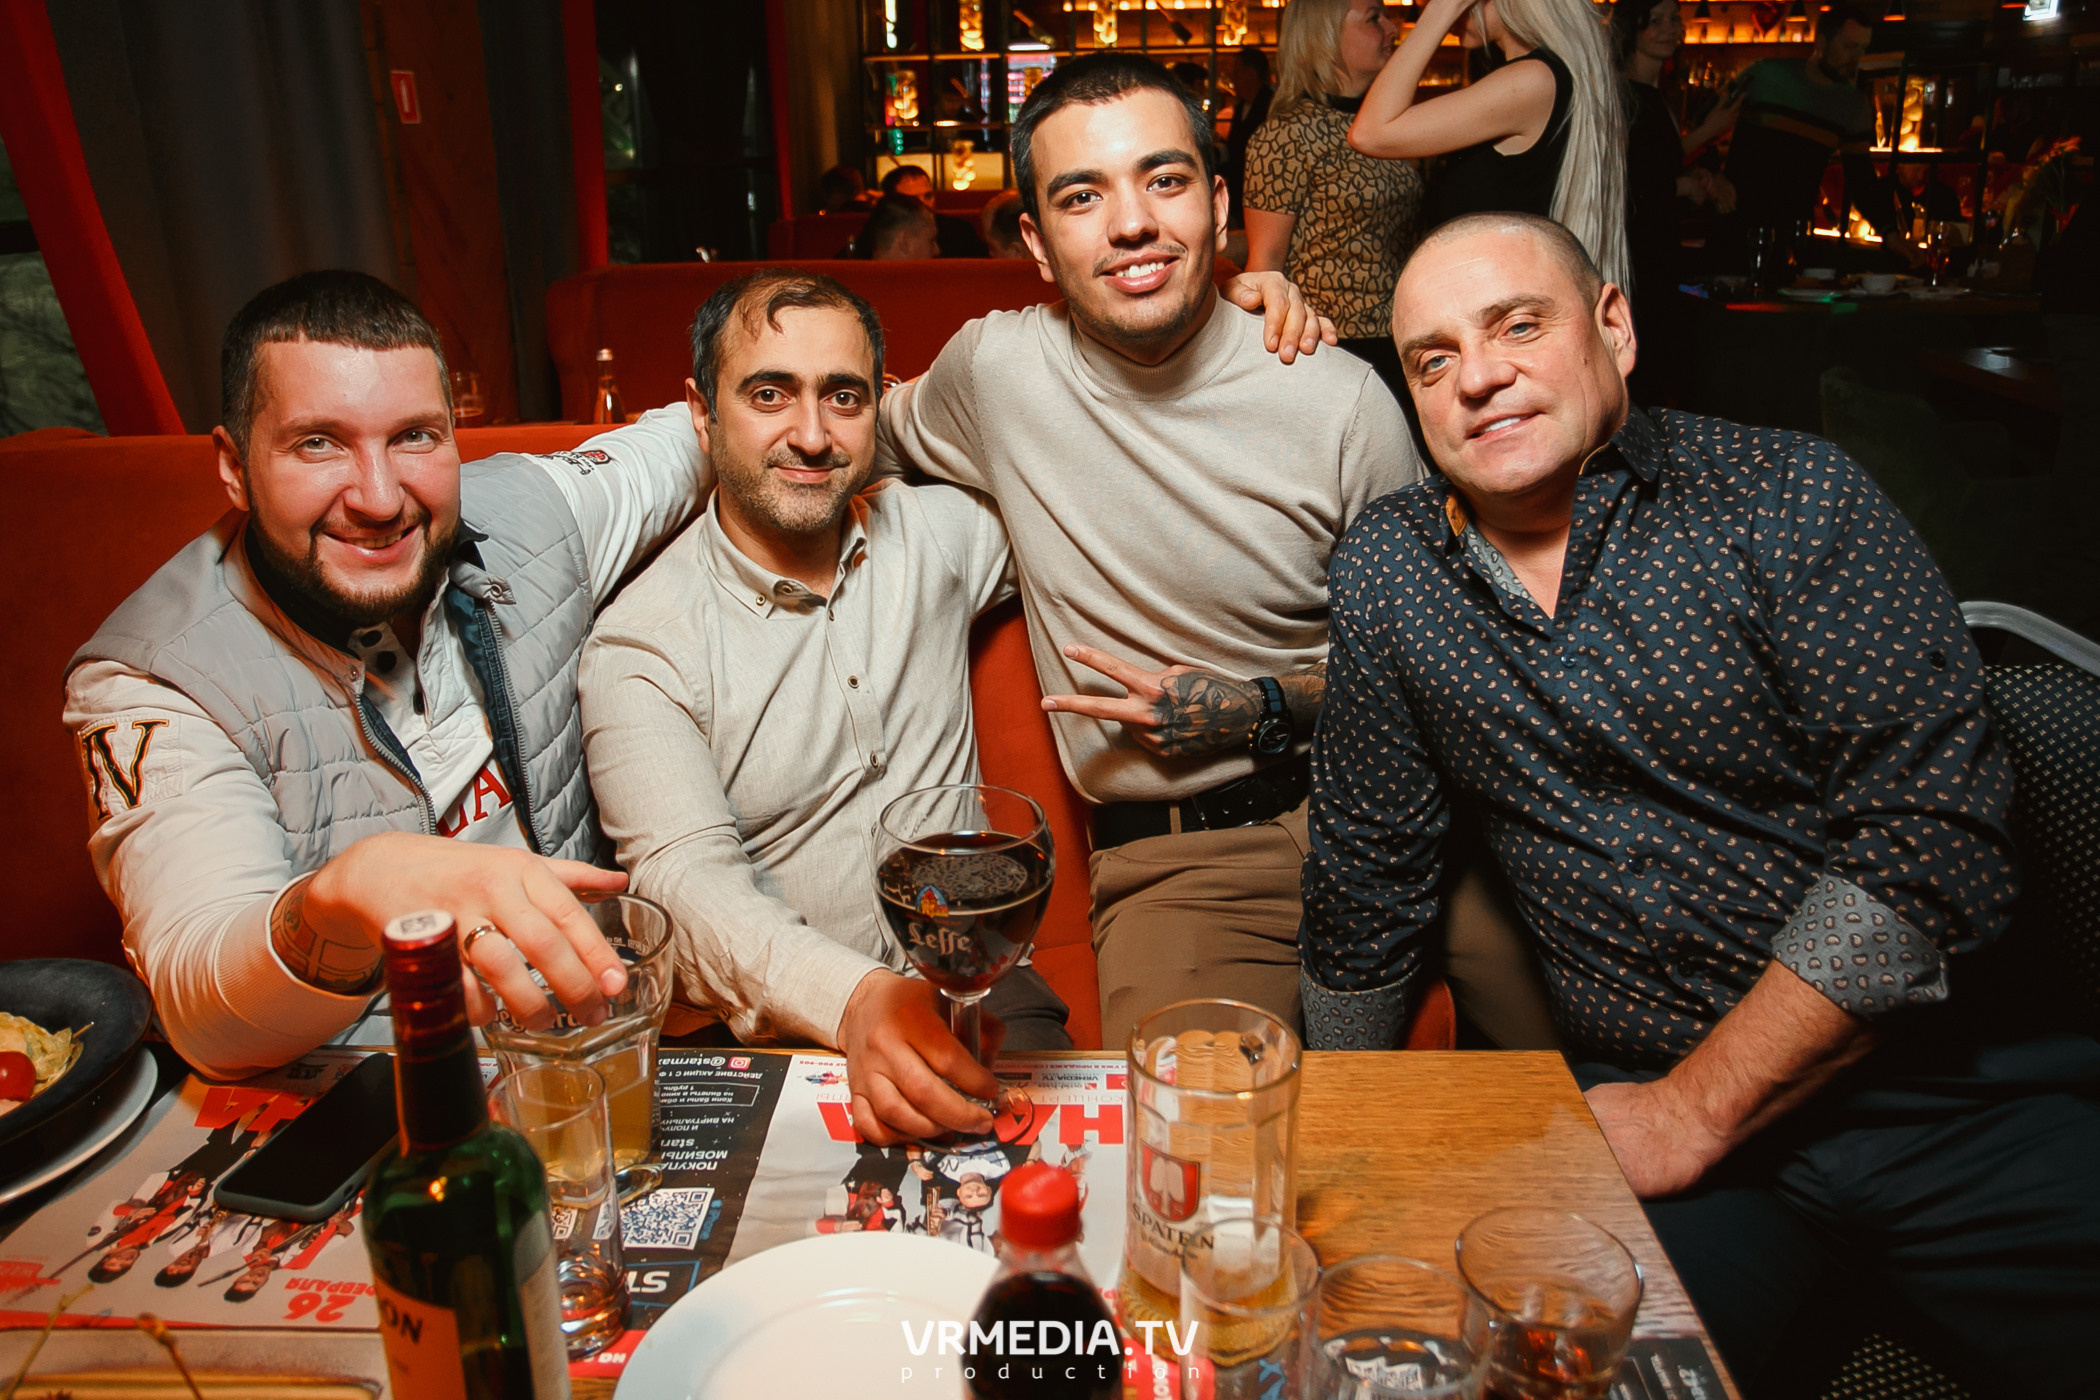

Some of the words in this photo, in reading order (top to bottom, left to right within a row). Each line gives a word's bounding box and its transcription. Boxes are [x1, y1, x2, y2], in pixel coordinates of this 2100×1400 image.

[908, 922, 971, 956] Leffe
[683, 1069, 714, 1077] АКЦИИ
[715, 1071, 763, 1079] ДЕЙСТВИЕ
[660, 1117, 720, 1126] ВИРТУАЛЬНУ
[660, 1161, 718, 1170] ПОКУПА
[1132, 1202, 1215, 1250] SPATEN
[624, 1270, 671, 1293] ST
[282, 1292, 356, 1323] 26
[380, 1298, 423, 1346] ON
